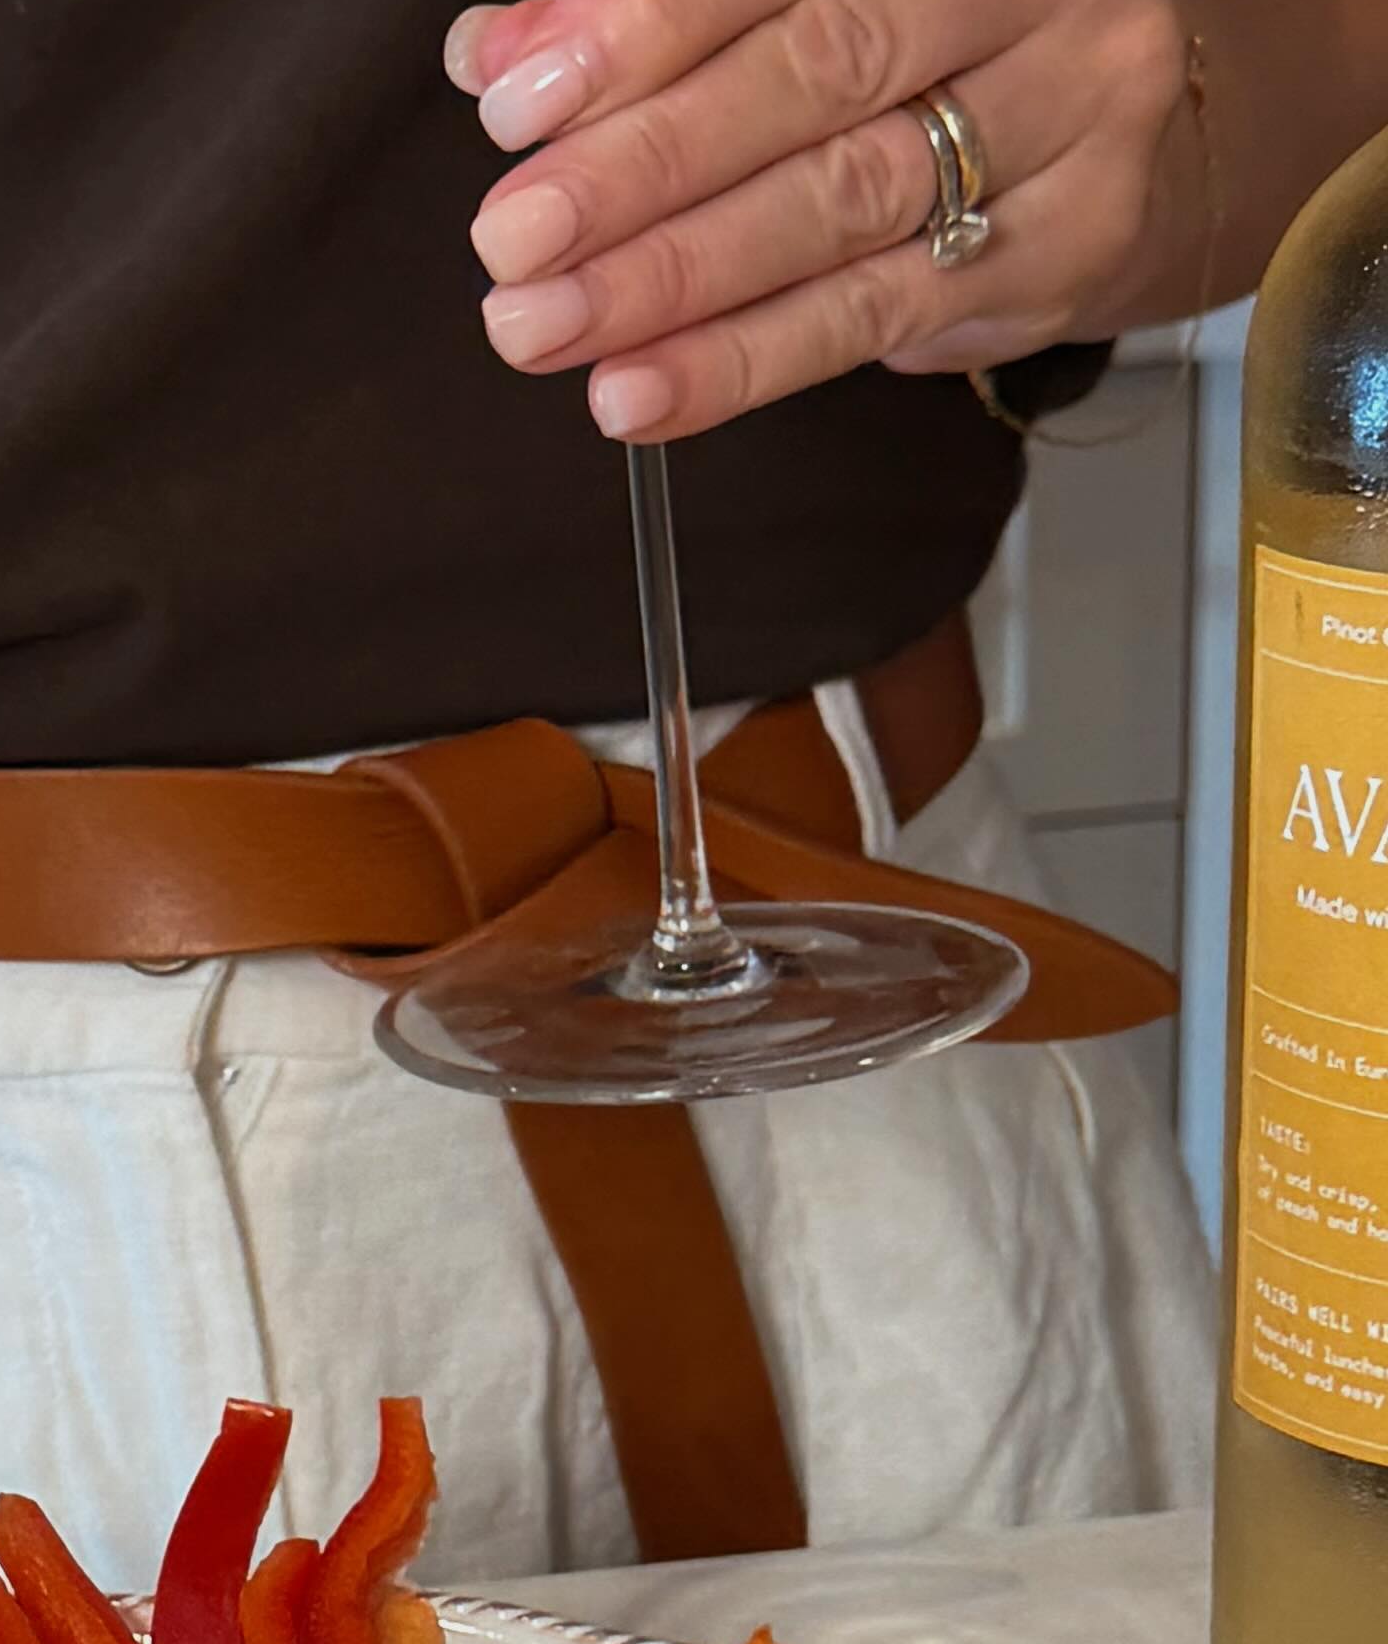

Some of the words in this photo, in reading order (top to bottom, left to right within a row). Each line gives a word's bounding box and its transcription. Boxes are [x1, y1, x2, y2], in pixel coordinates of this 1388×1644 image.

[1321, 614, 1381, 645] Pinot
[1296, 884, 1359, 924] Made
[1261, 1023, 1319, 1063] Crafted
[1326, 1049, 1347, 1072] in
[1285, 1172, 1312, 1194] and
[1327, 1215, 1359, 1235] and
[1256, 1277, 1298, 1314] PAIRS
[1308, 1305, 1353, 1332] WELL
[1303, 1371, 1335, 1392] and
[1340, 1384, 1386, 1410] easy
